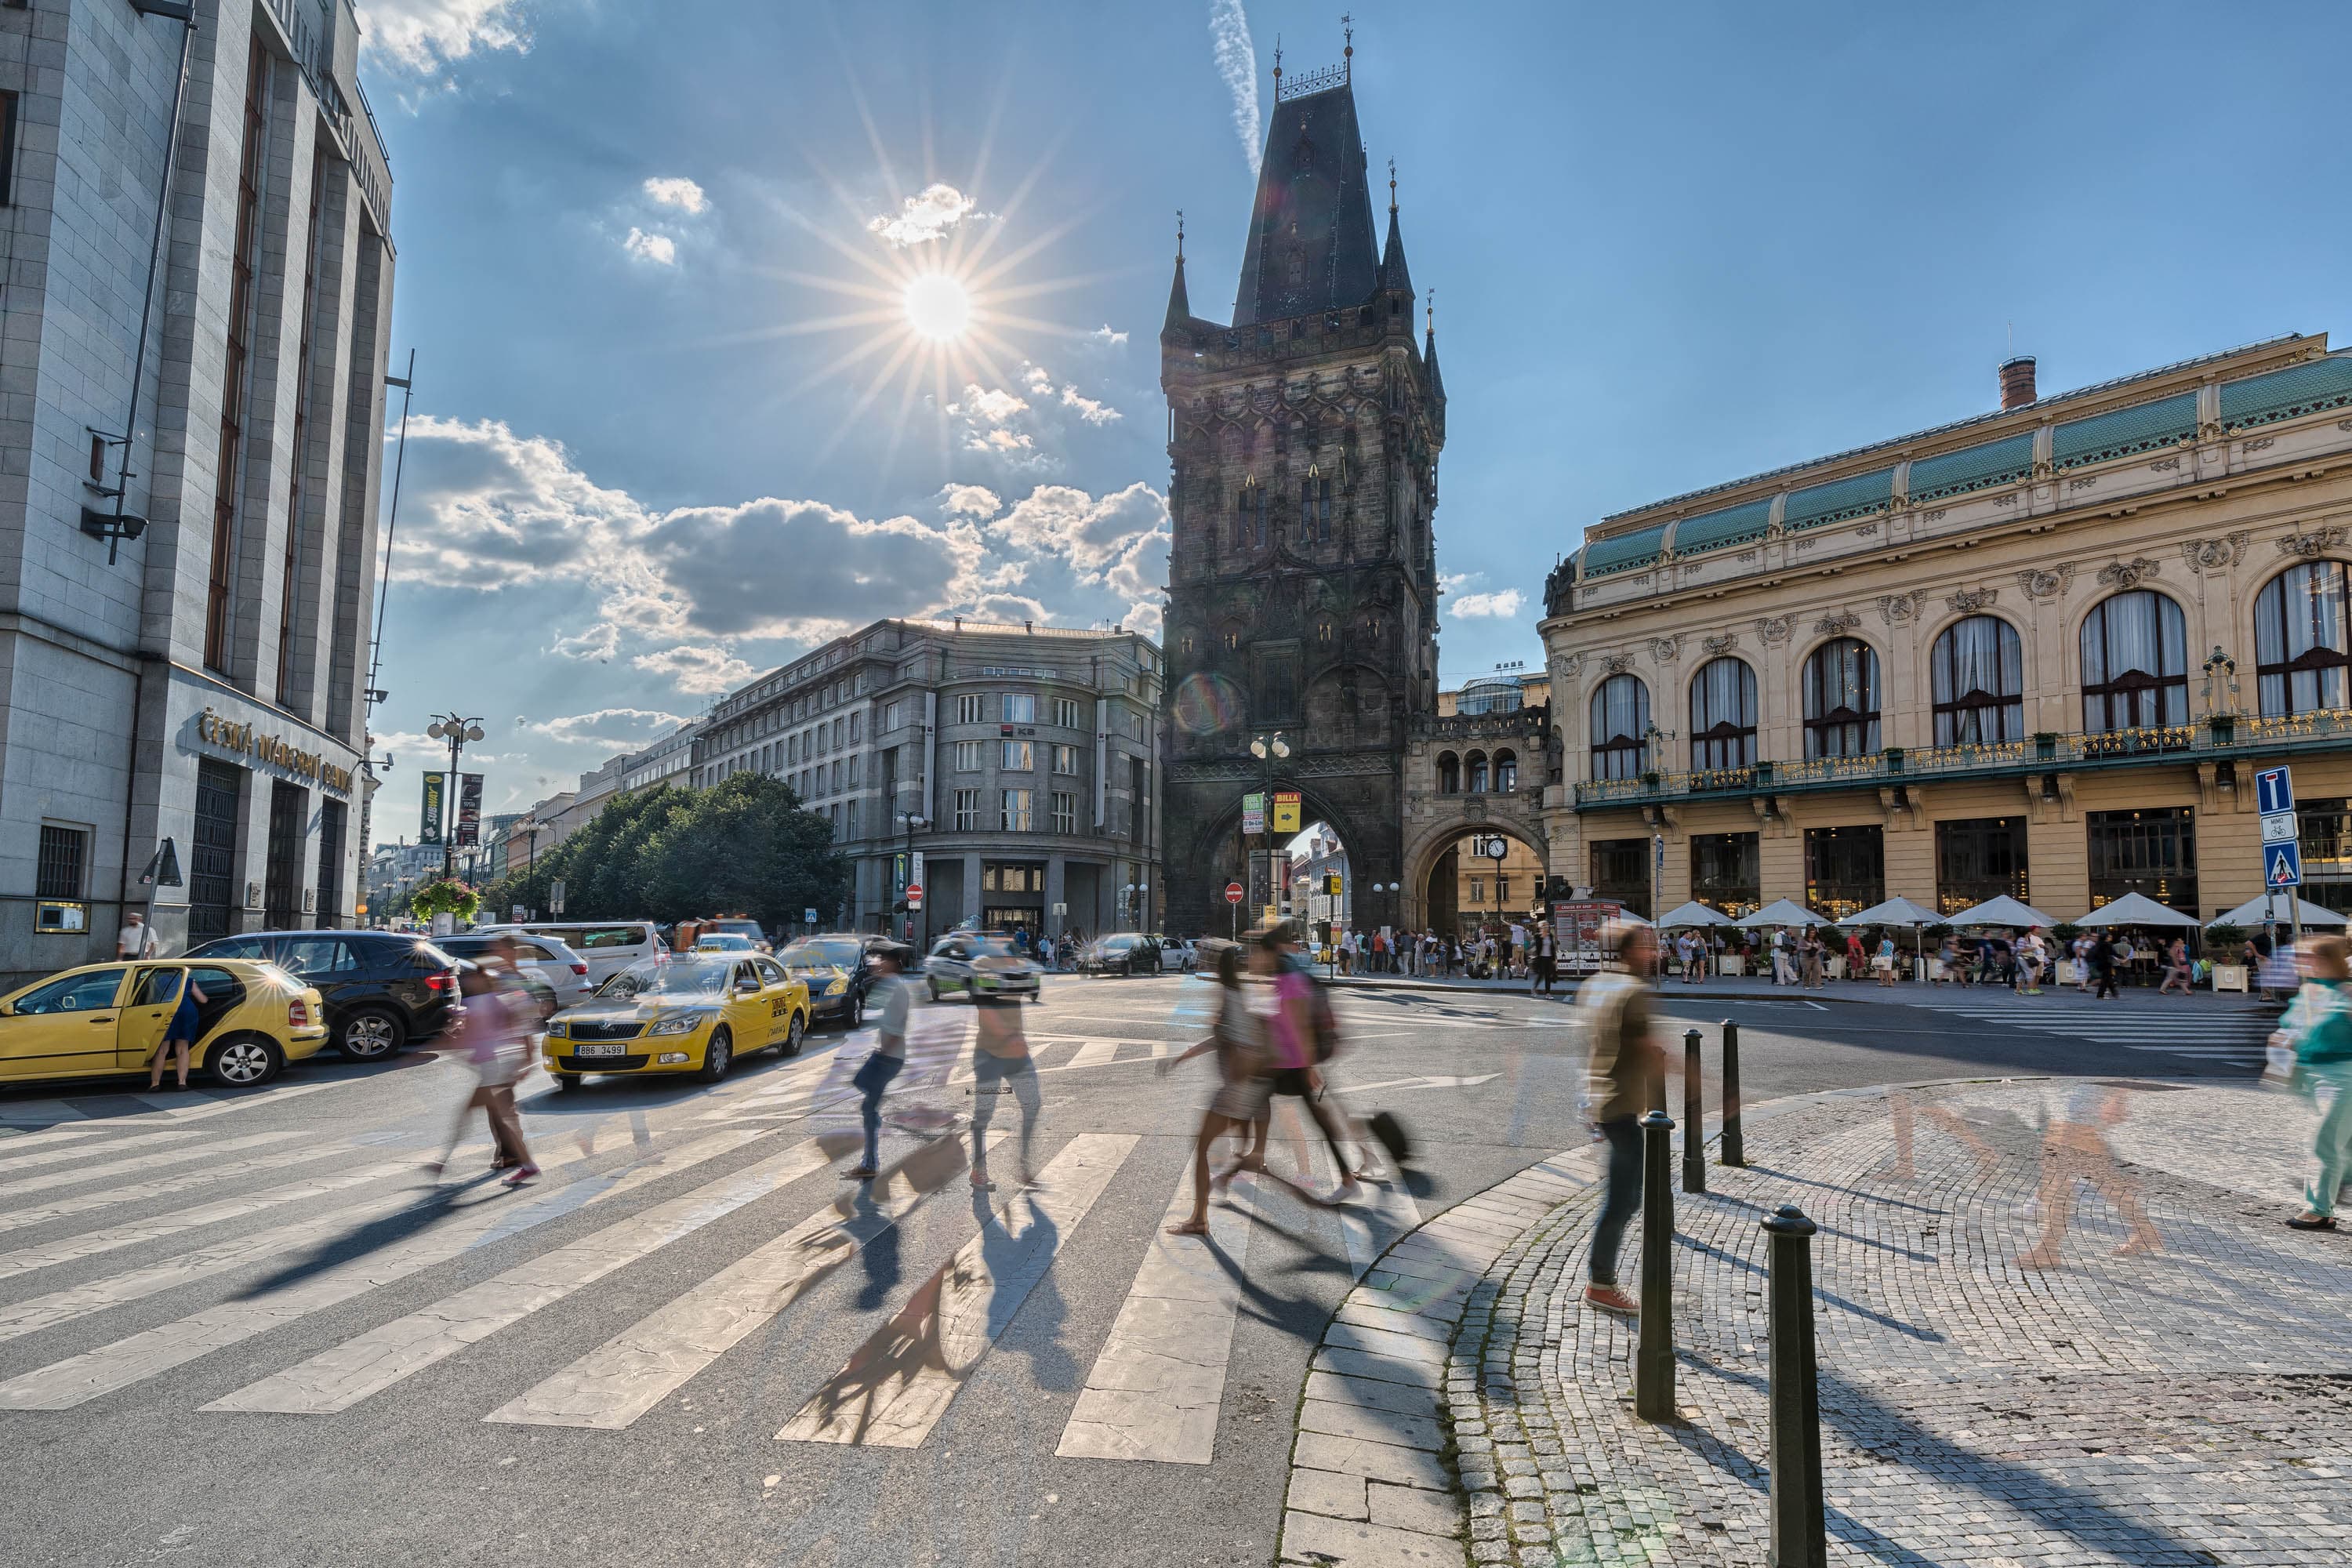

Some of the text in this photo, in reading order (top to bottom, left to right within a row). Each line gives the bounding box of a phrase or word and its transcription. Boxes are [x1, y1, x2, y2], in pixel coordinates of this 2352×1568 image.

[199, 706, 252, 756] ČESKÁ
[259, 734, 321, 780] NÁRODNÍ
[427, 786, 438, 825] SUBWAY
[581, 1046, 622, 1054] 8B6 3499
